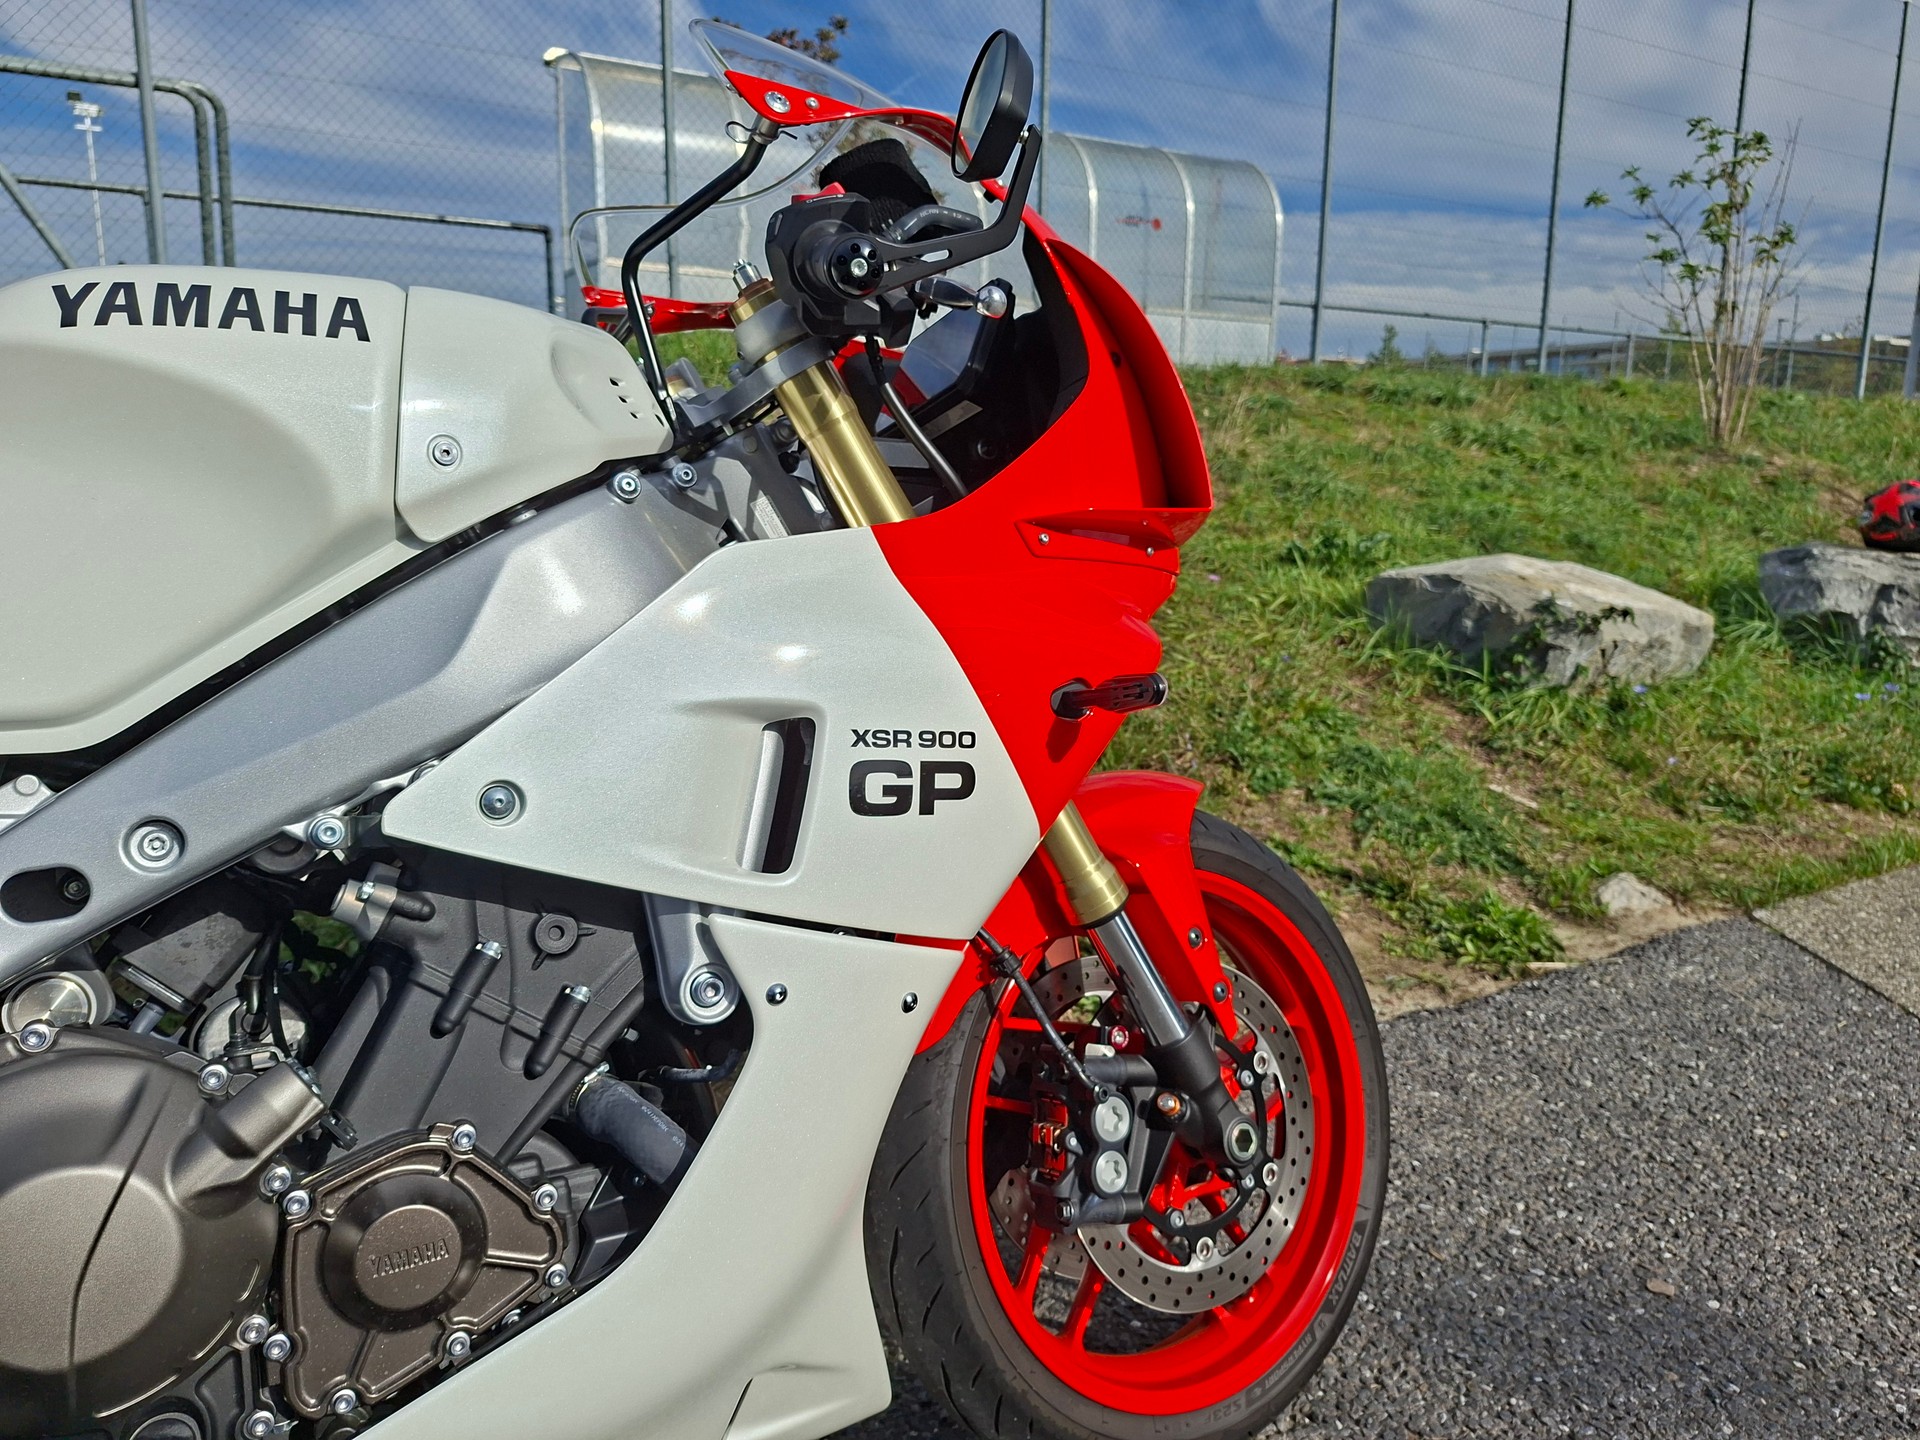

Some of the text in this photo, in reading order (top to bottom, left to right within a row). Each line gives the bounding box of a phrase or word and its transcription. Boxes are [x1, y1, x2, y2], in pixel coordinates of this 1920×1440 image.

[51, 281, 371, 343] YAMAHA
[850, 728, 977, 749] XSR 900
[849, 759, 976, 817] GP
[367, 1238, 450, 1279] YAMAHA
[1329, 1230, 1361, 1305] BATTLAX
